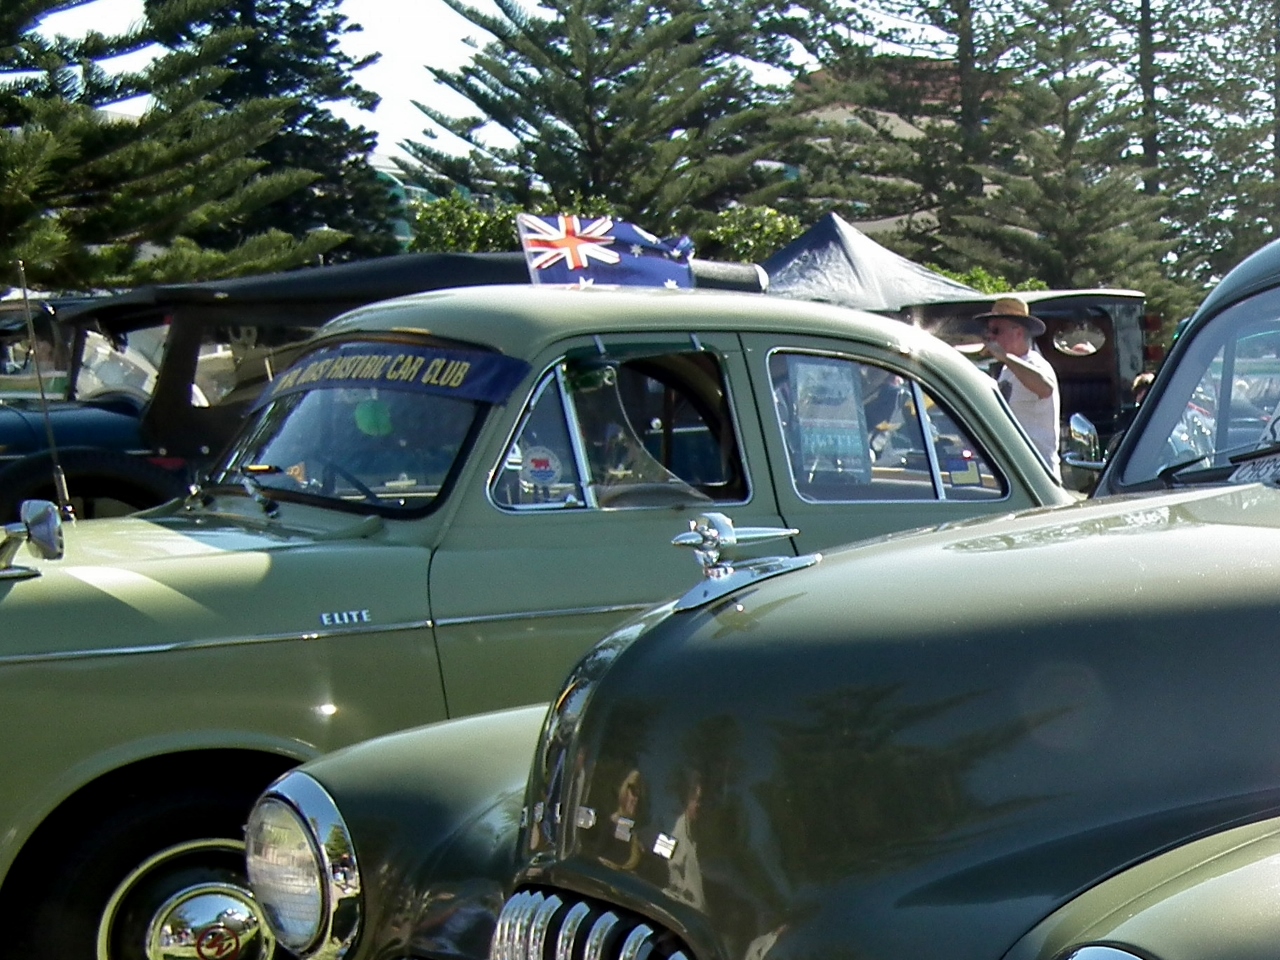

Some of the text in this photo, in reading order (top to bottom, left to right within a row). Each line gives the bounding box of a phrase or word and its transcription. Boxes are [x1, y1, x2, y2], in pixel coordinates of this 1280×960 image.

[386, 353, 423, 382] CAR
[421, 358, 471, 388] CLUB
[321, 609, 372, 626] ELITE
